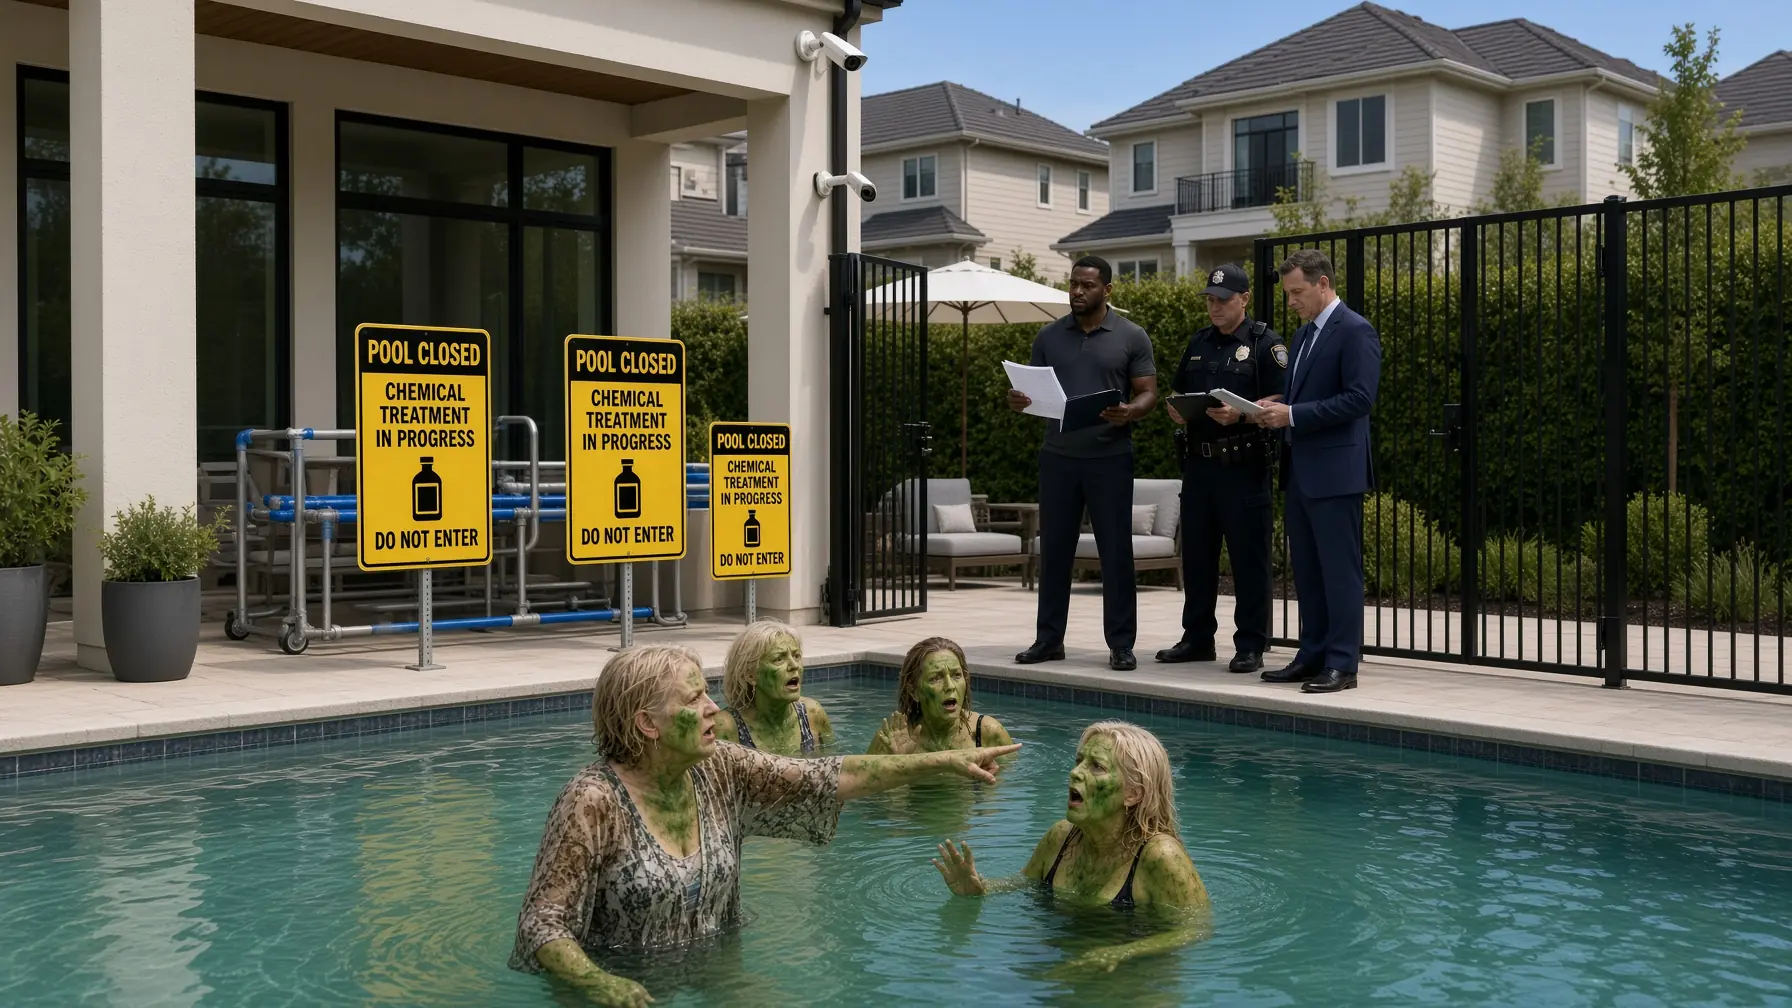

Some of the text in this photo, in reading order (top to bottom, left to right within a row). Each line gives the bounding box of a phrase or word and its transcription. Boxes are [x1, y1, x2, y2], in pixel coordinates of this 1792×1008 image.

[369, 340, 480, 365] POOL CLOSED
[577, 350, 676, 374] POOL CLOSED
[386, 382, 465, 401] CHEMICAL
[592, 389, 663, 407] CHEMICAL
[380, 406, 470, 424] TREATMENT
[586, 412, 667, 428] TREATMENT
[377, 430, 474, 447] IN PROGRESS
[583, 434, 671, 450] IN PROGRESS
[717, 433, 786, 449] POOL CLOSED
[728, 461, 776, 473] CHEMICAL
[724, 476, 779, 488] TREATMENT
[720, 492, 782, 504] IN PROGRESS
[376, 529, 478, 550] DO NOT ENTER
[582, 526, 674, 545] DO NOT ENTER
[720, 551, 785, 566] DO NOT ENTER
